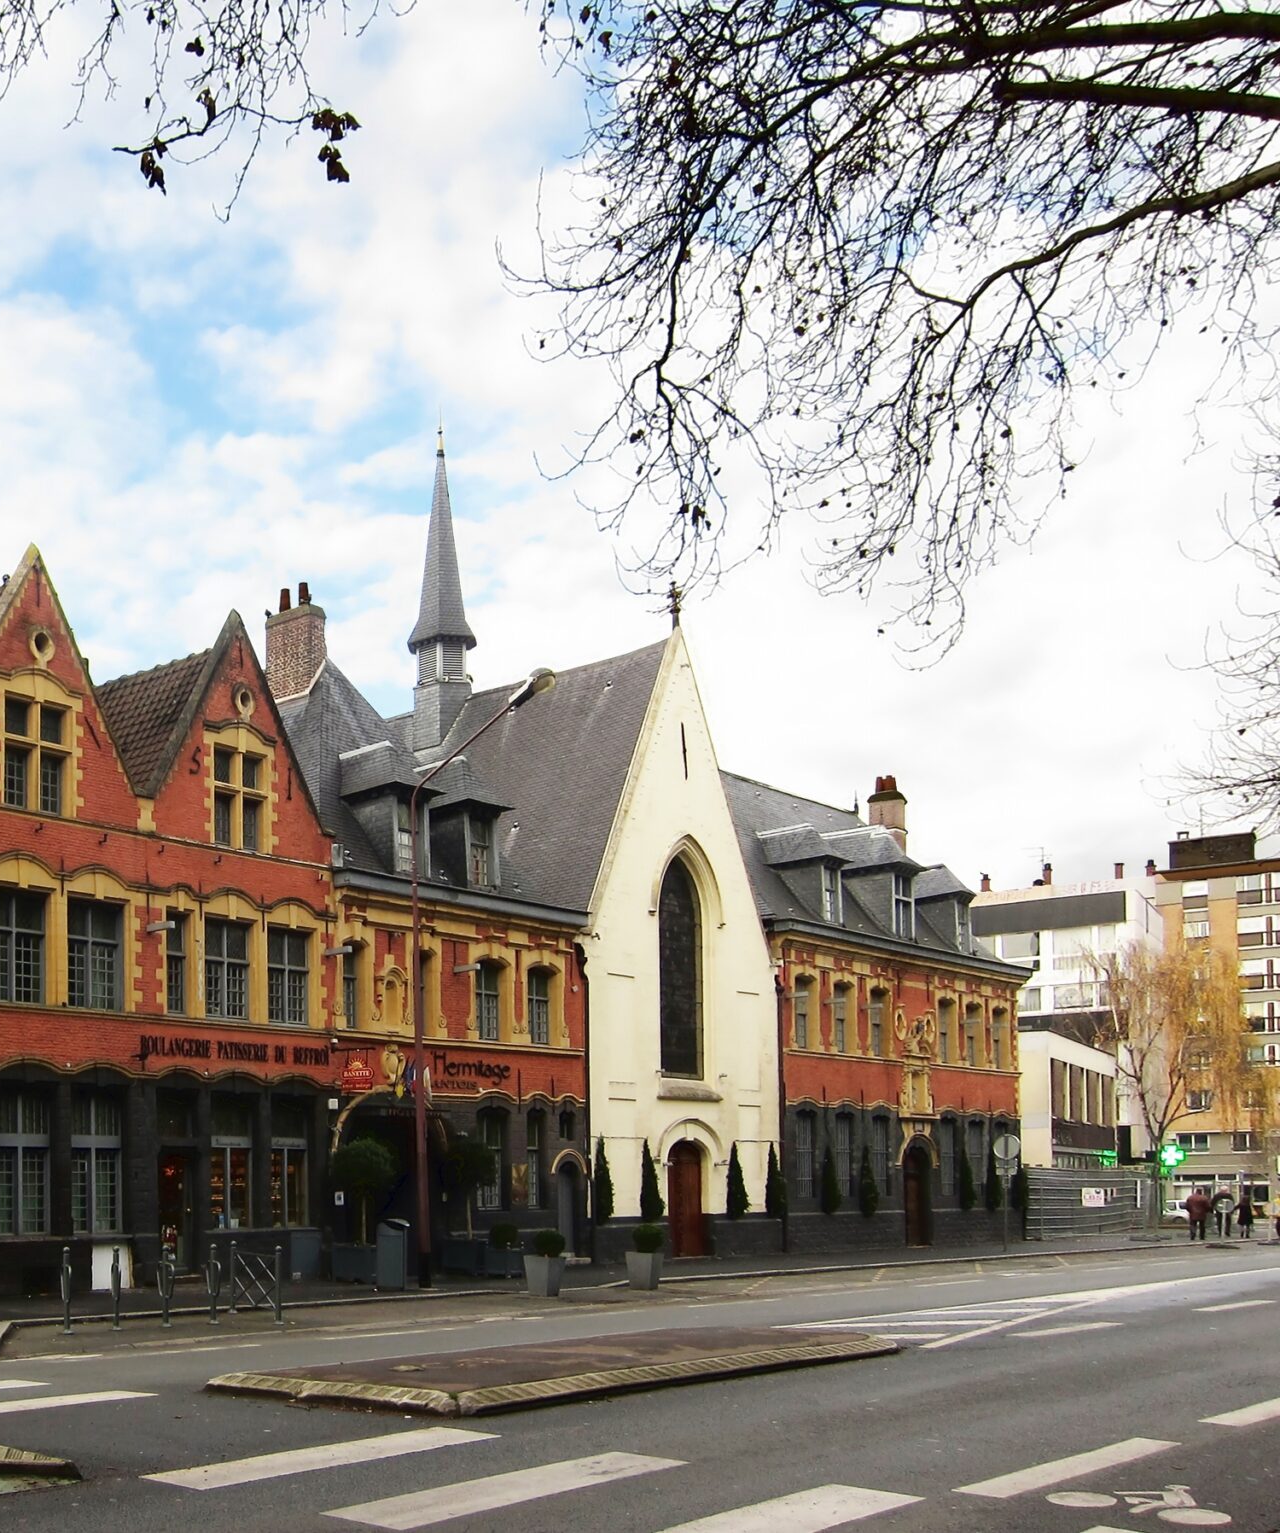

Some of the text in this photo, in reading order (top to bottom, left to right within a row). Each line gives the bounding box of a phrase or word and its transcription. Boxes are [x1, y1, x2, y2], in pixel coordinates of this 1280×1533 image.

[140, 1035, 211, 1058] BOULANGERIE
[217, 1041, 269, 1062] PATISSERIE
[274, 1045, 287, 1064] DU
[343, 1070, 370, 1078] BANETTE
